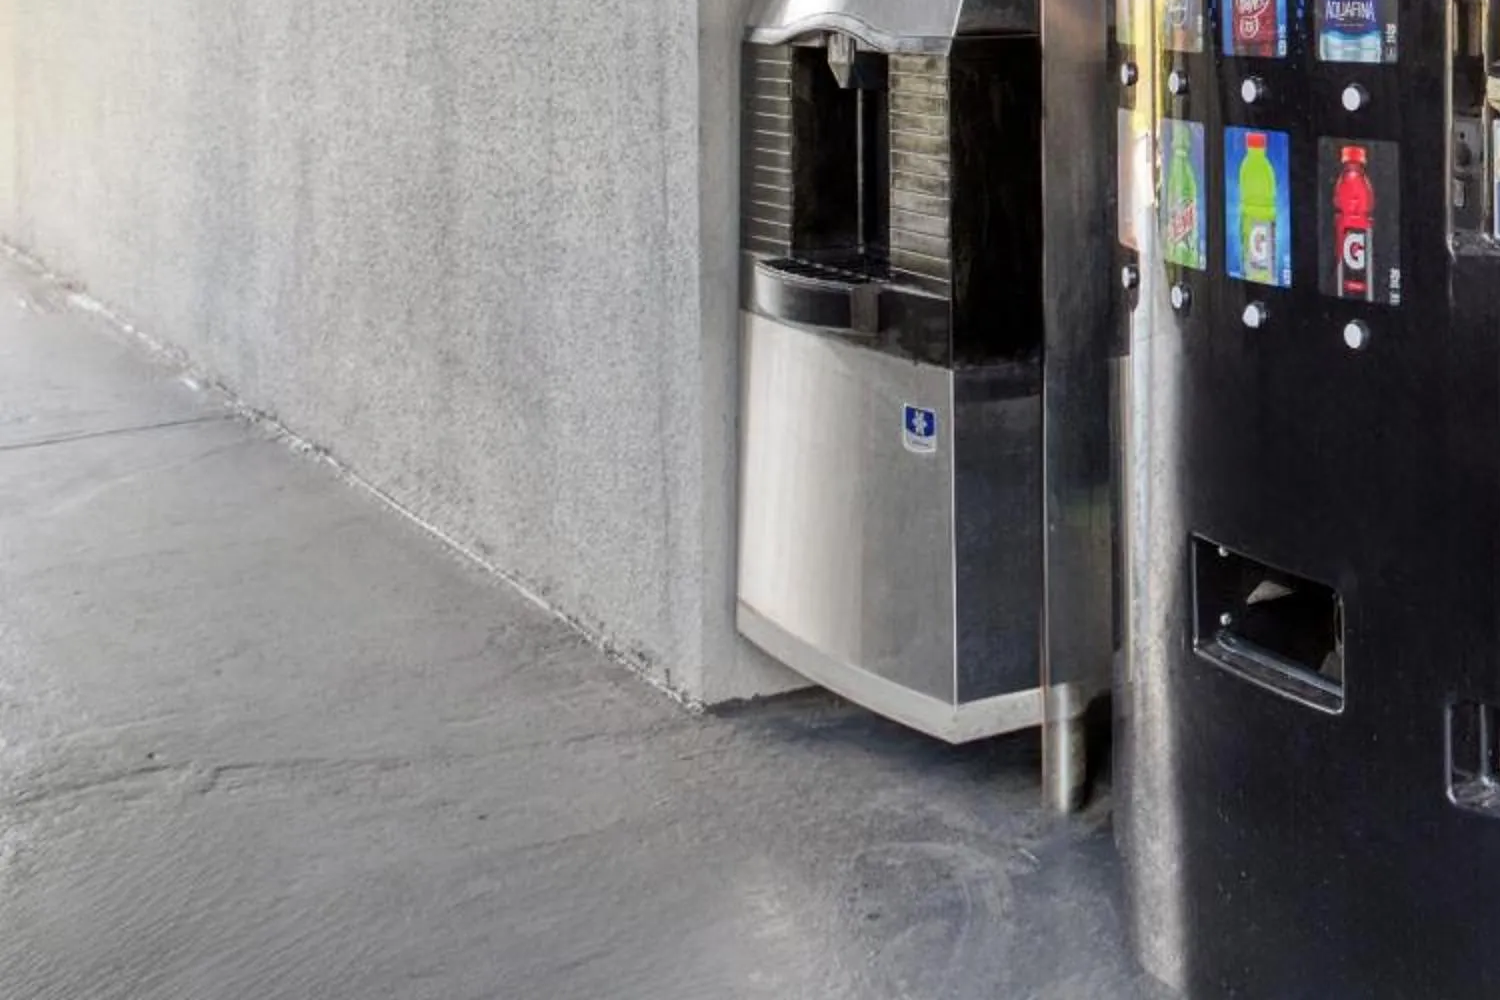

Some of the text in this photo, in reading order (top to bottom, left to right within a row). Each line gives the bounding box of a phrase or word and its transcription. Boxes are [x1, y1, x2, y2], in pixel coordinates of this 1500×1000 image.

[1325, 0, 1377, 23] AQUAFINA
[1250, 226, 1268, 261] G
[1343, 232, 1365, 270] G
